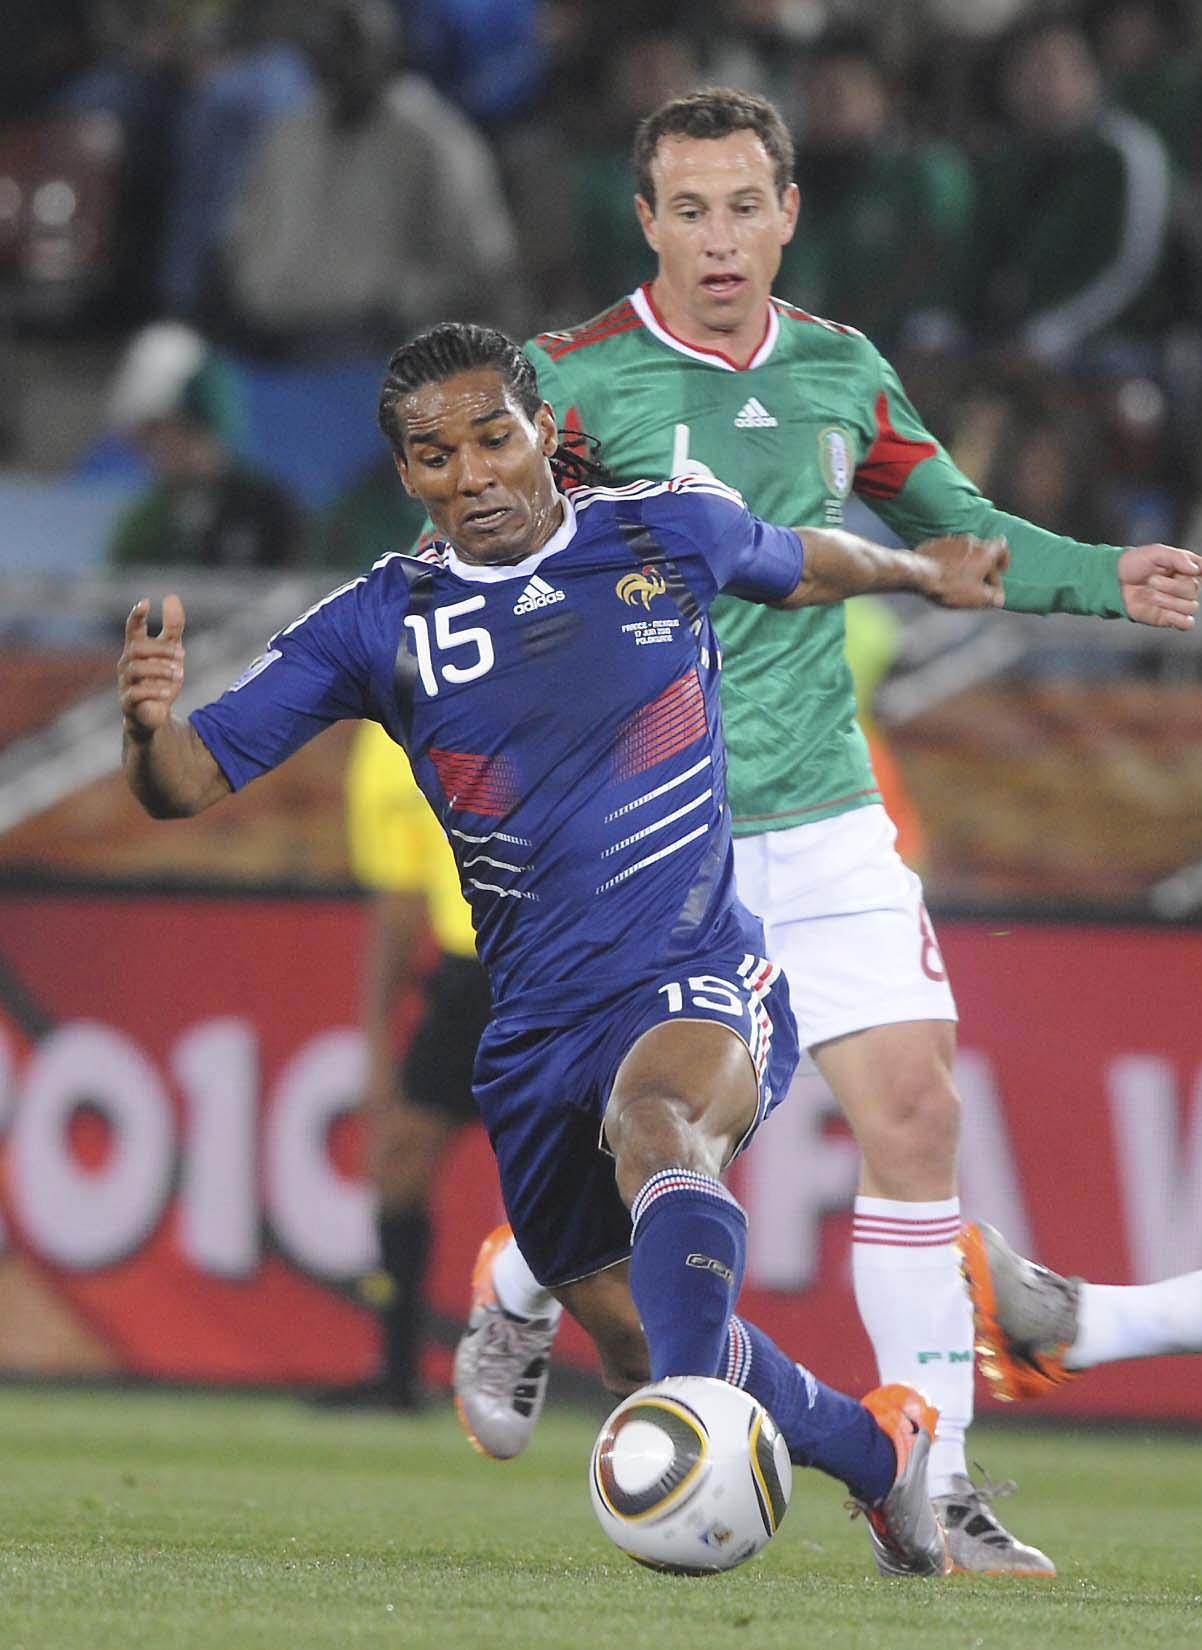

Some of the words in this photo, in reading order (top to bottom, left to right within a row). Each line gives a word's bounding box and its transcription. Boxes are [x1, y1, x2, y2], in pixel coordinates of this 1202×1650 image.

[513, 589, 566, 616] adidas
[403, 594, 495, 697] 15
[657, 974, 744, 1016] 15
[0, 1017, 382, 1284] 010
